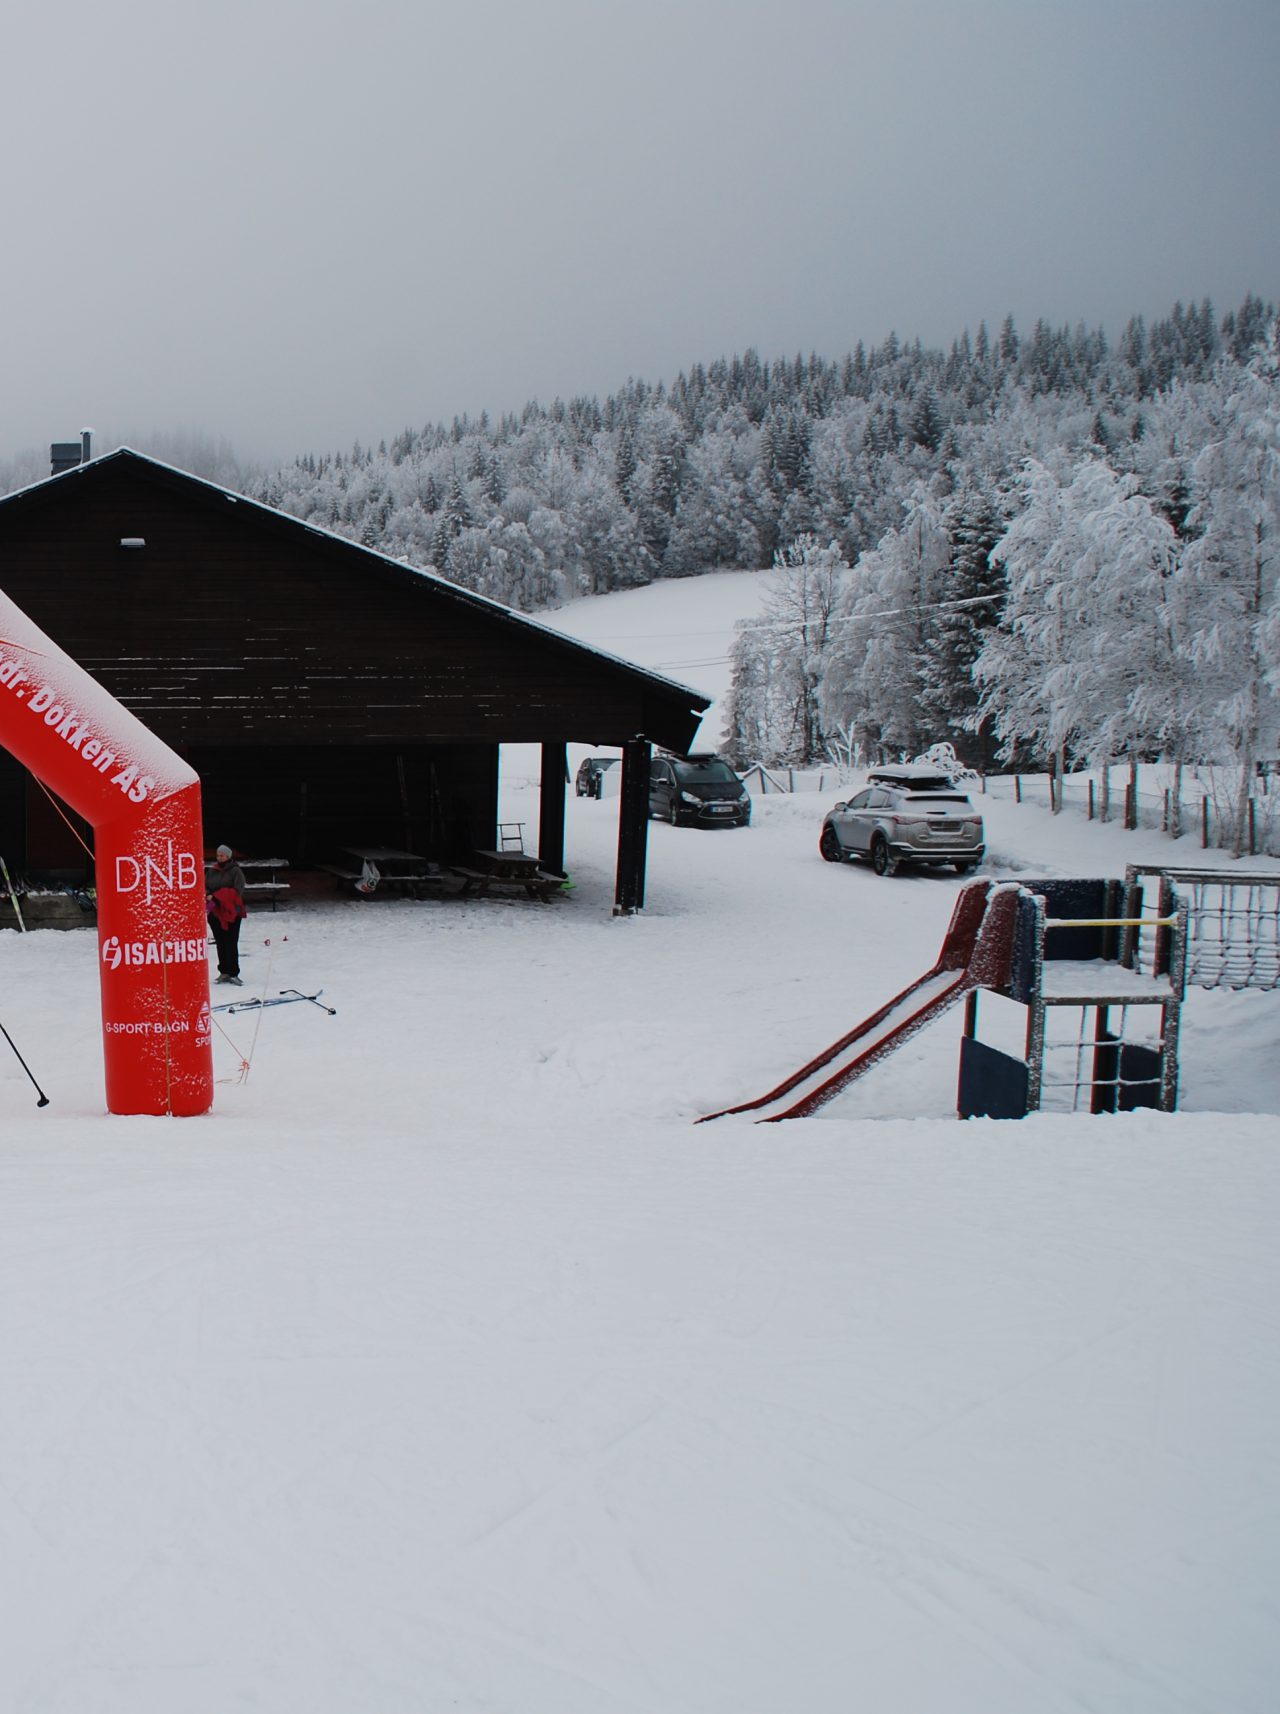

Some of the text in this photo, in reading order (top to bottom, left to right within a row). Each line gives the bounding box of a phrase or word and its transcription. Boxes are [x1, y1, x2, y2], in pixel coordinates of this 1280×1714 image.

[26, 686, 115, 774] Dokken
[110, 764, 155, 803] AS
[115, 839, 197, 905] DNB
[105, 1021, 190, 1034] G-SPORT BAGN
